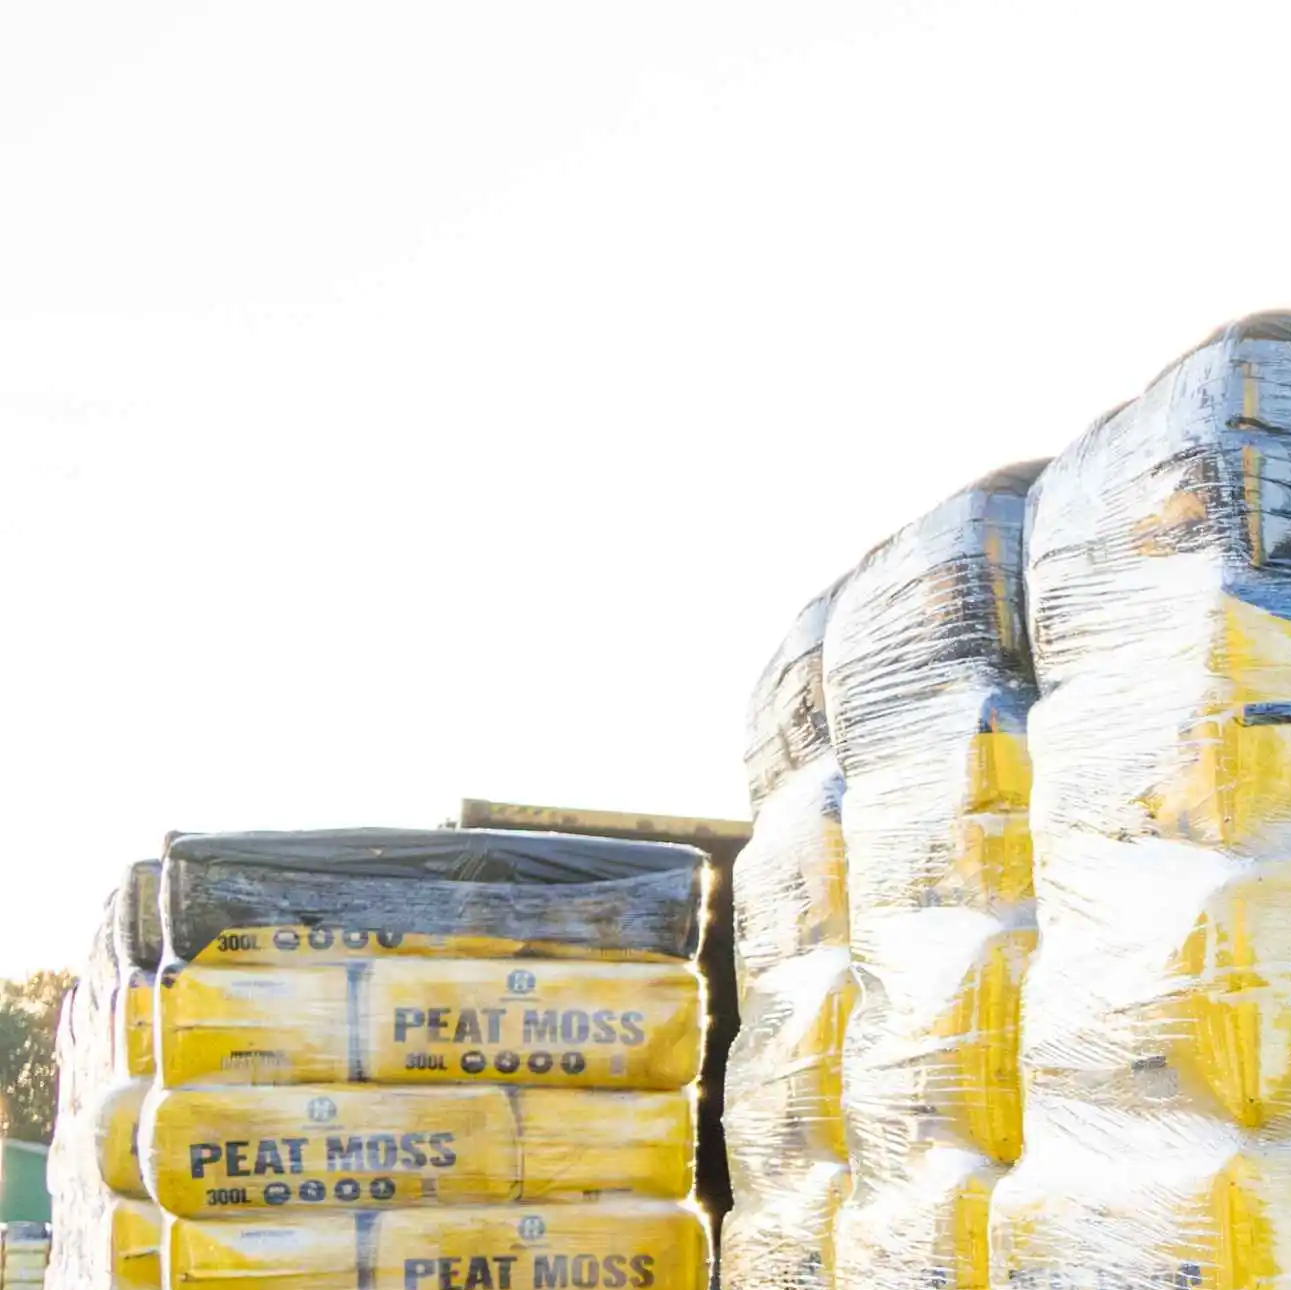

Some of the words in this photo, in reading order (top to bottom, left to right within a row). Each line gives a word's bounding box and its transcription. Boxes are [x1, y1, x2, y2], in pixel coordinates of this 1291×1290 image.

[217, 934, 262, 952] 300L
[394, 1007, 507, 1044] PEAT
[522, 1009, 645, 1045] MOSS
[190, 1137, 310, 1179] PEAT
[326, 1132, 457, 1173] MOSS
[206, 1188, 252, 1206] 300L
[533, 1253, 655, 1290] MOSS
